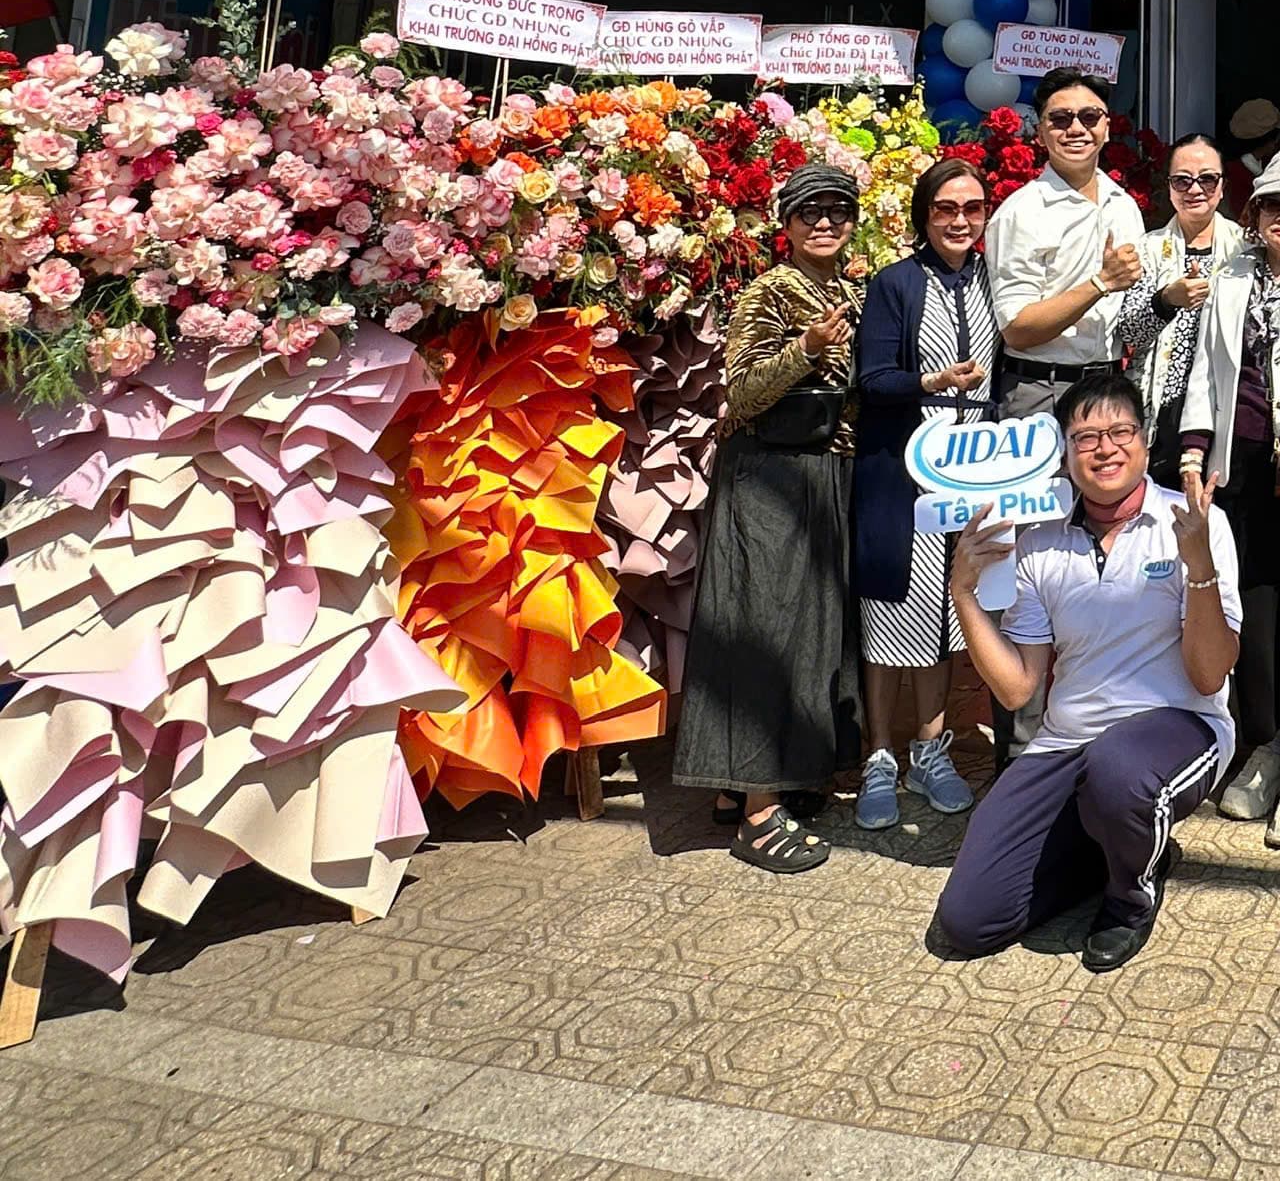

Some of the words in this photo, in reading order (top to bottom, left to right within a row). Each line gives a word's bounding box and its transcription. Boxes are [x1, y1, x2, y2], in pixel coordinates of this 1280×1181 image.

[428, 3, 478, 22] CHÚC
[481, 12, 507, 26] GĐ
[512, 17, 571, 38] NHUNG
[409, 20, 440, 36] KHAI
[444, 26, 494, 45] TRƯƠNG
[498, 33, 520, 51] ĐẠI
[561, 43, 593, 58] PHÁT
[934, 424, 1037, 468] JIDAI
[999, 490, 1056, 518] Phú
